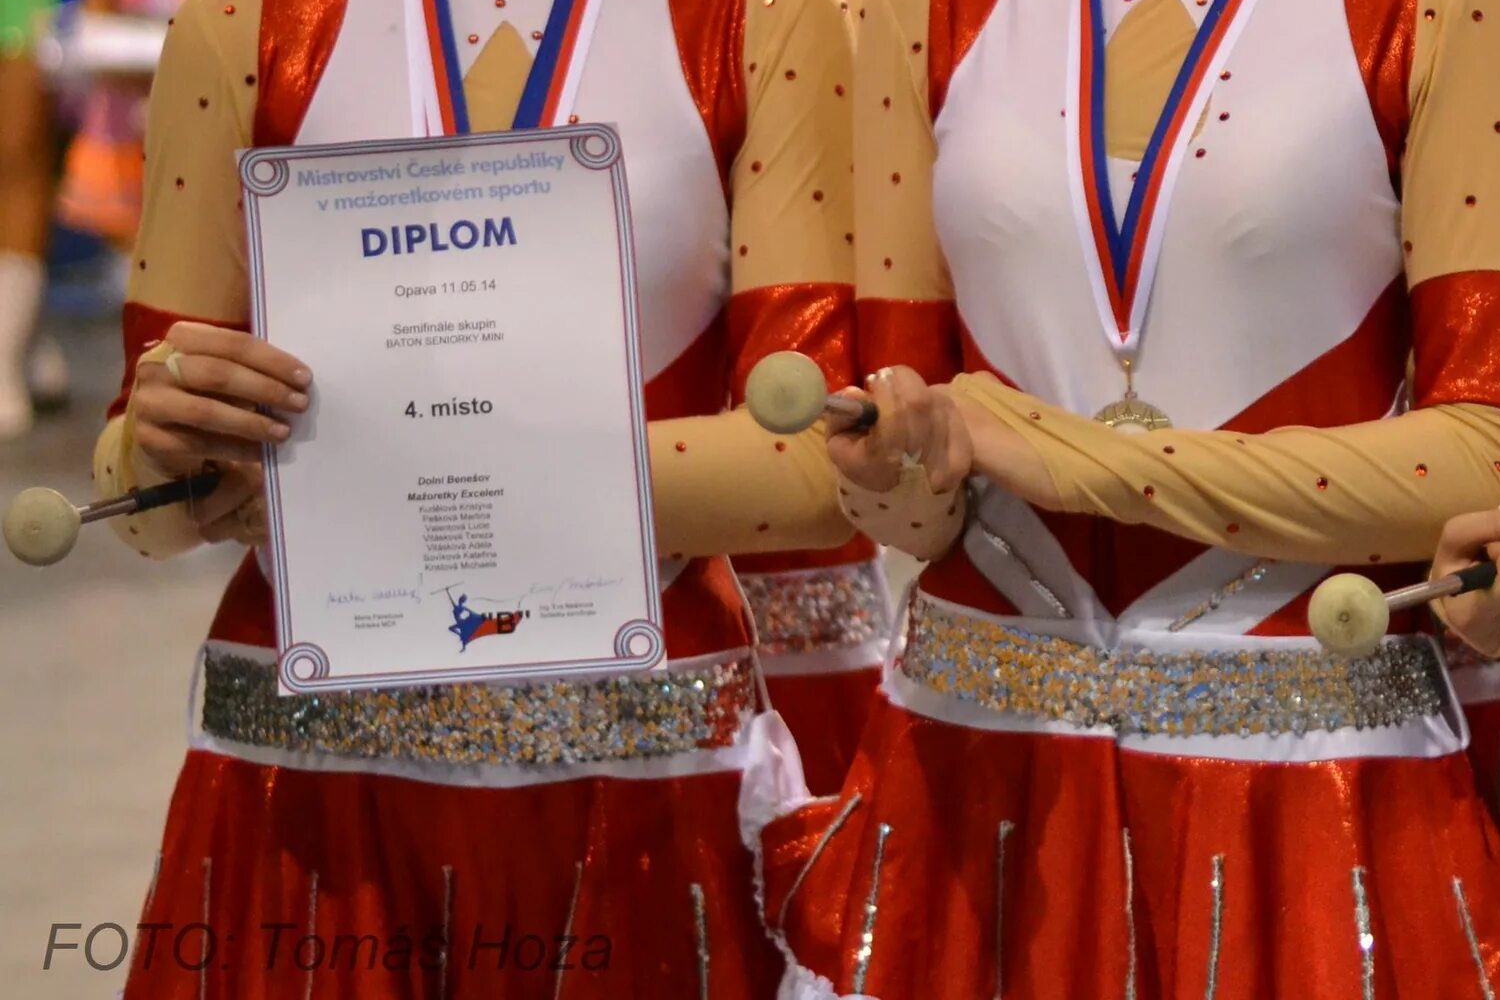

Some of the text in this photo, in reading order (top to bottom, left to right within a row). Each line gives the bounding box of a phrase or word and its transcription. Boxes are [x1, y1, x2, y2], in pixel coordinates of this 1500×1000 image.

[296, 152, 566, 187] Mistrovství České republiky
[317, 180, 551, 211] v mažoretkovém sportu
[361, 216, 517, 258] DIPLOM
[394, 279, 496, 298] Opava 11.05.14
[393, 319, 497, 335] Semifinále skupin
[386, 332, 504, 349] BATON SENIORKY MINI
[404, 397, 493, 418] 4. místo
[447, 473, 491, 484] Benešov
[407, 487, 504, 501] Mažoretky Excelent
